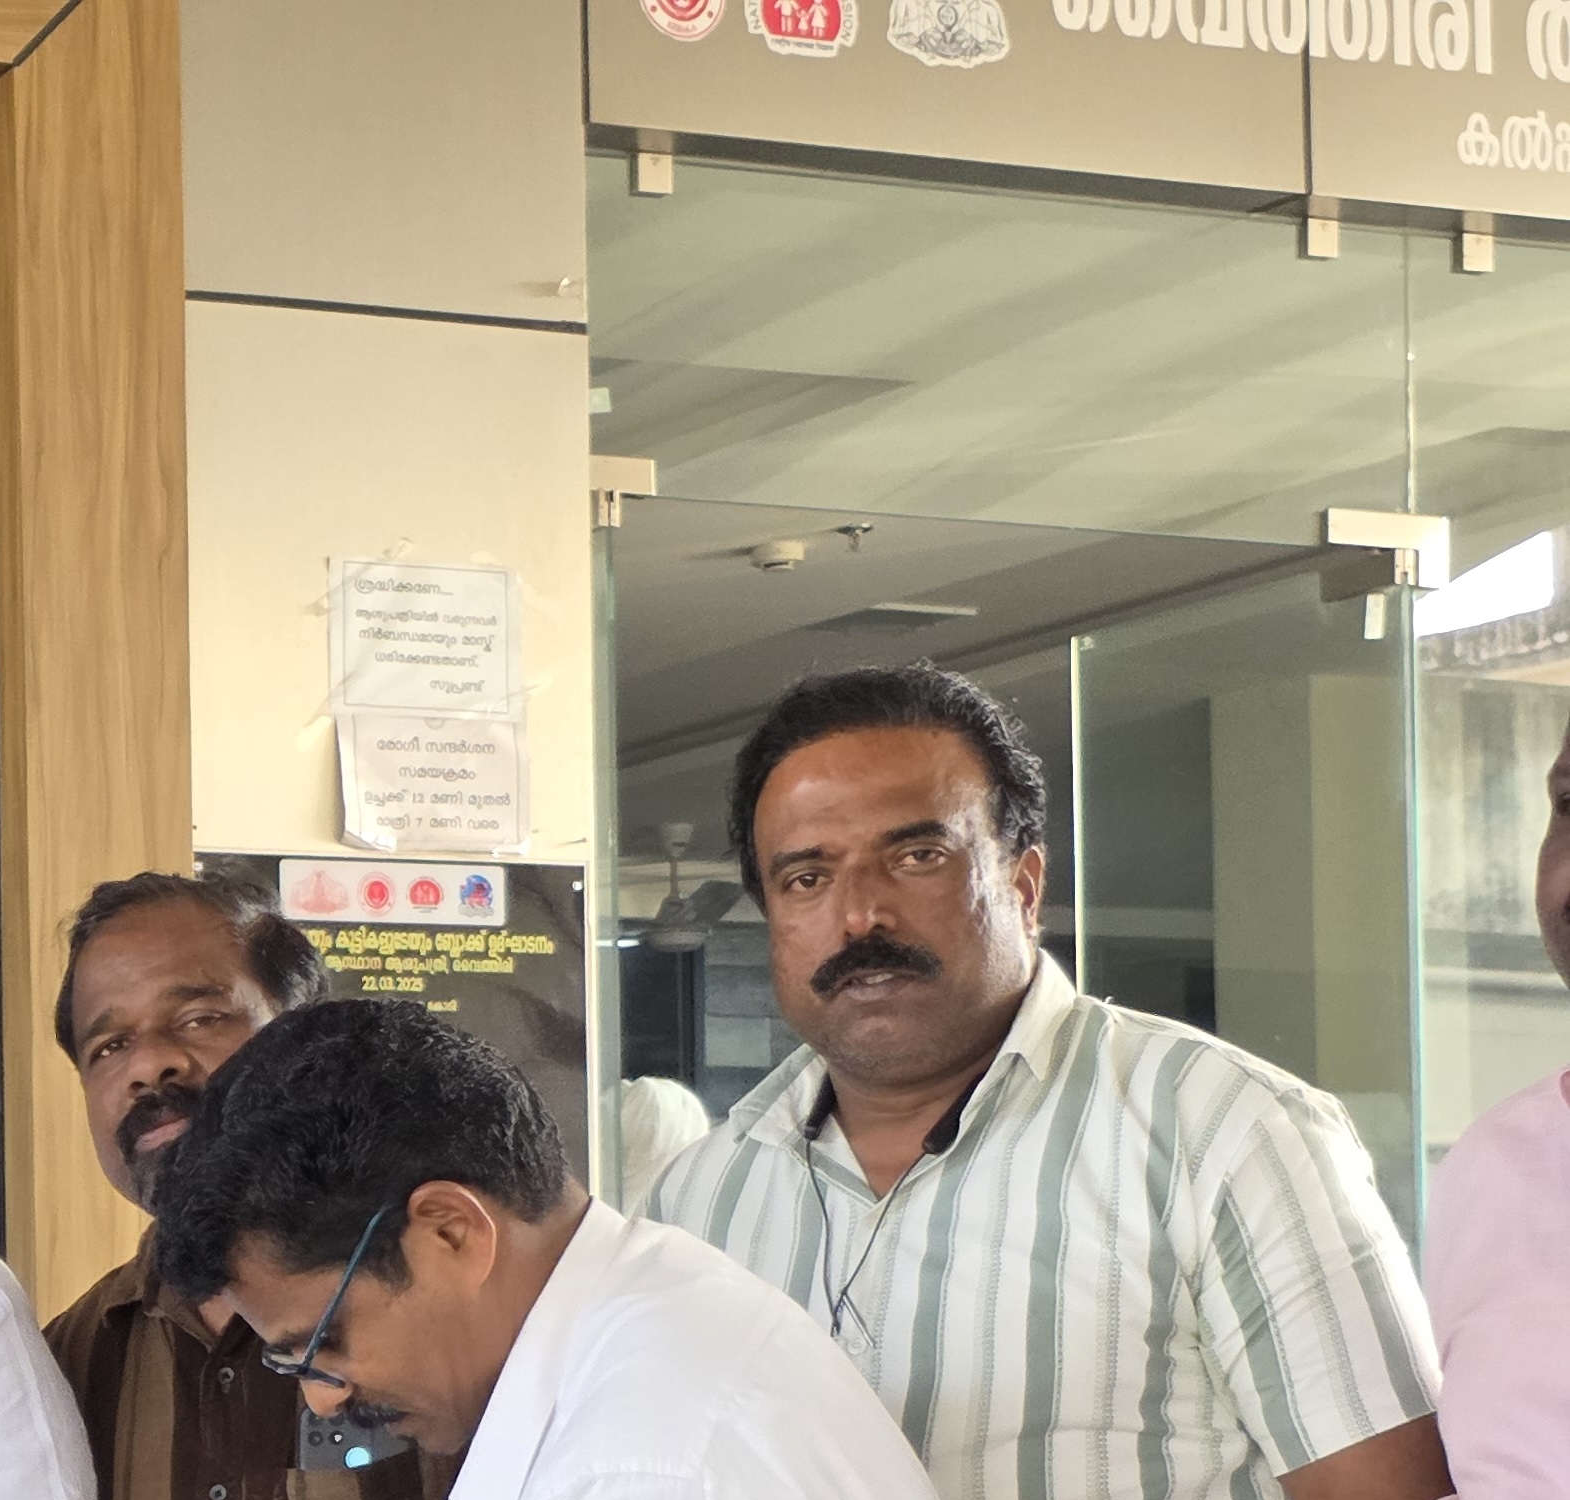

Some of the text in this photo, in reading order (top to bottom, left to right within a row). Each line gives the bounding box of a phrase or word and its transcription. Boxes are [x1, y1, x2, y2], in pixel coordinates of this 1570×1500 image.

[412, 793, 425, 804] 12
[431, 791, 464, 805] മണി
[468, 792, 511, 810] മുതൽ
[414, 817, 422, 828] 7
[430, 815, 462, 829] മണി
